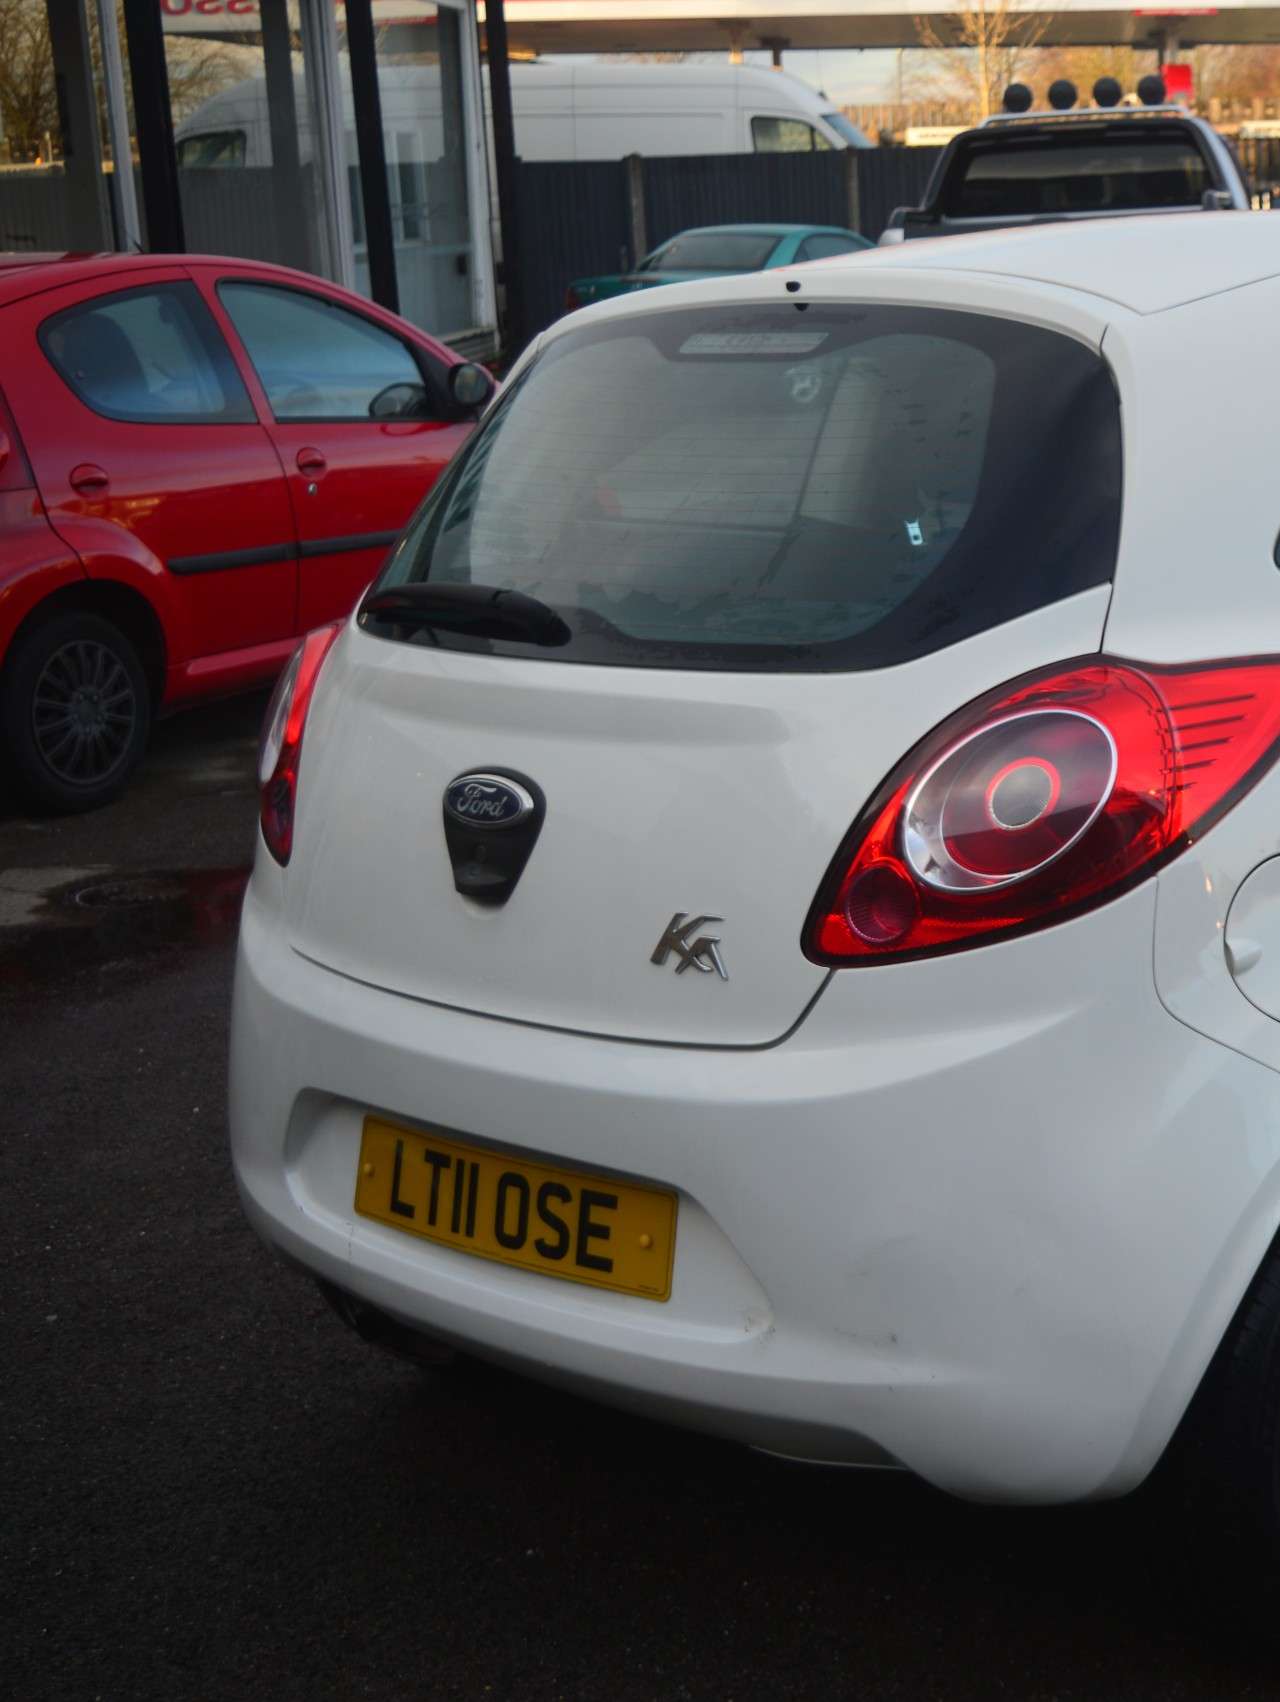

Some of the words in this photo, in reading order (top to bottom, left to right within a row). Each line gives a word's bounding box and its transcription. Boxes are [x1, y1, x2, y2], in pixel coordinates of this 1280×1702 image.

[456, 783, 506, 817] Ford
[391, 1139, 480, 1238] LT11
[495, 1172, 618, 1273] OSE
